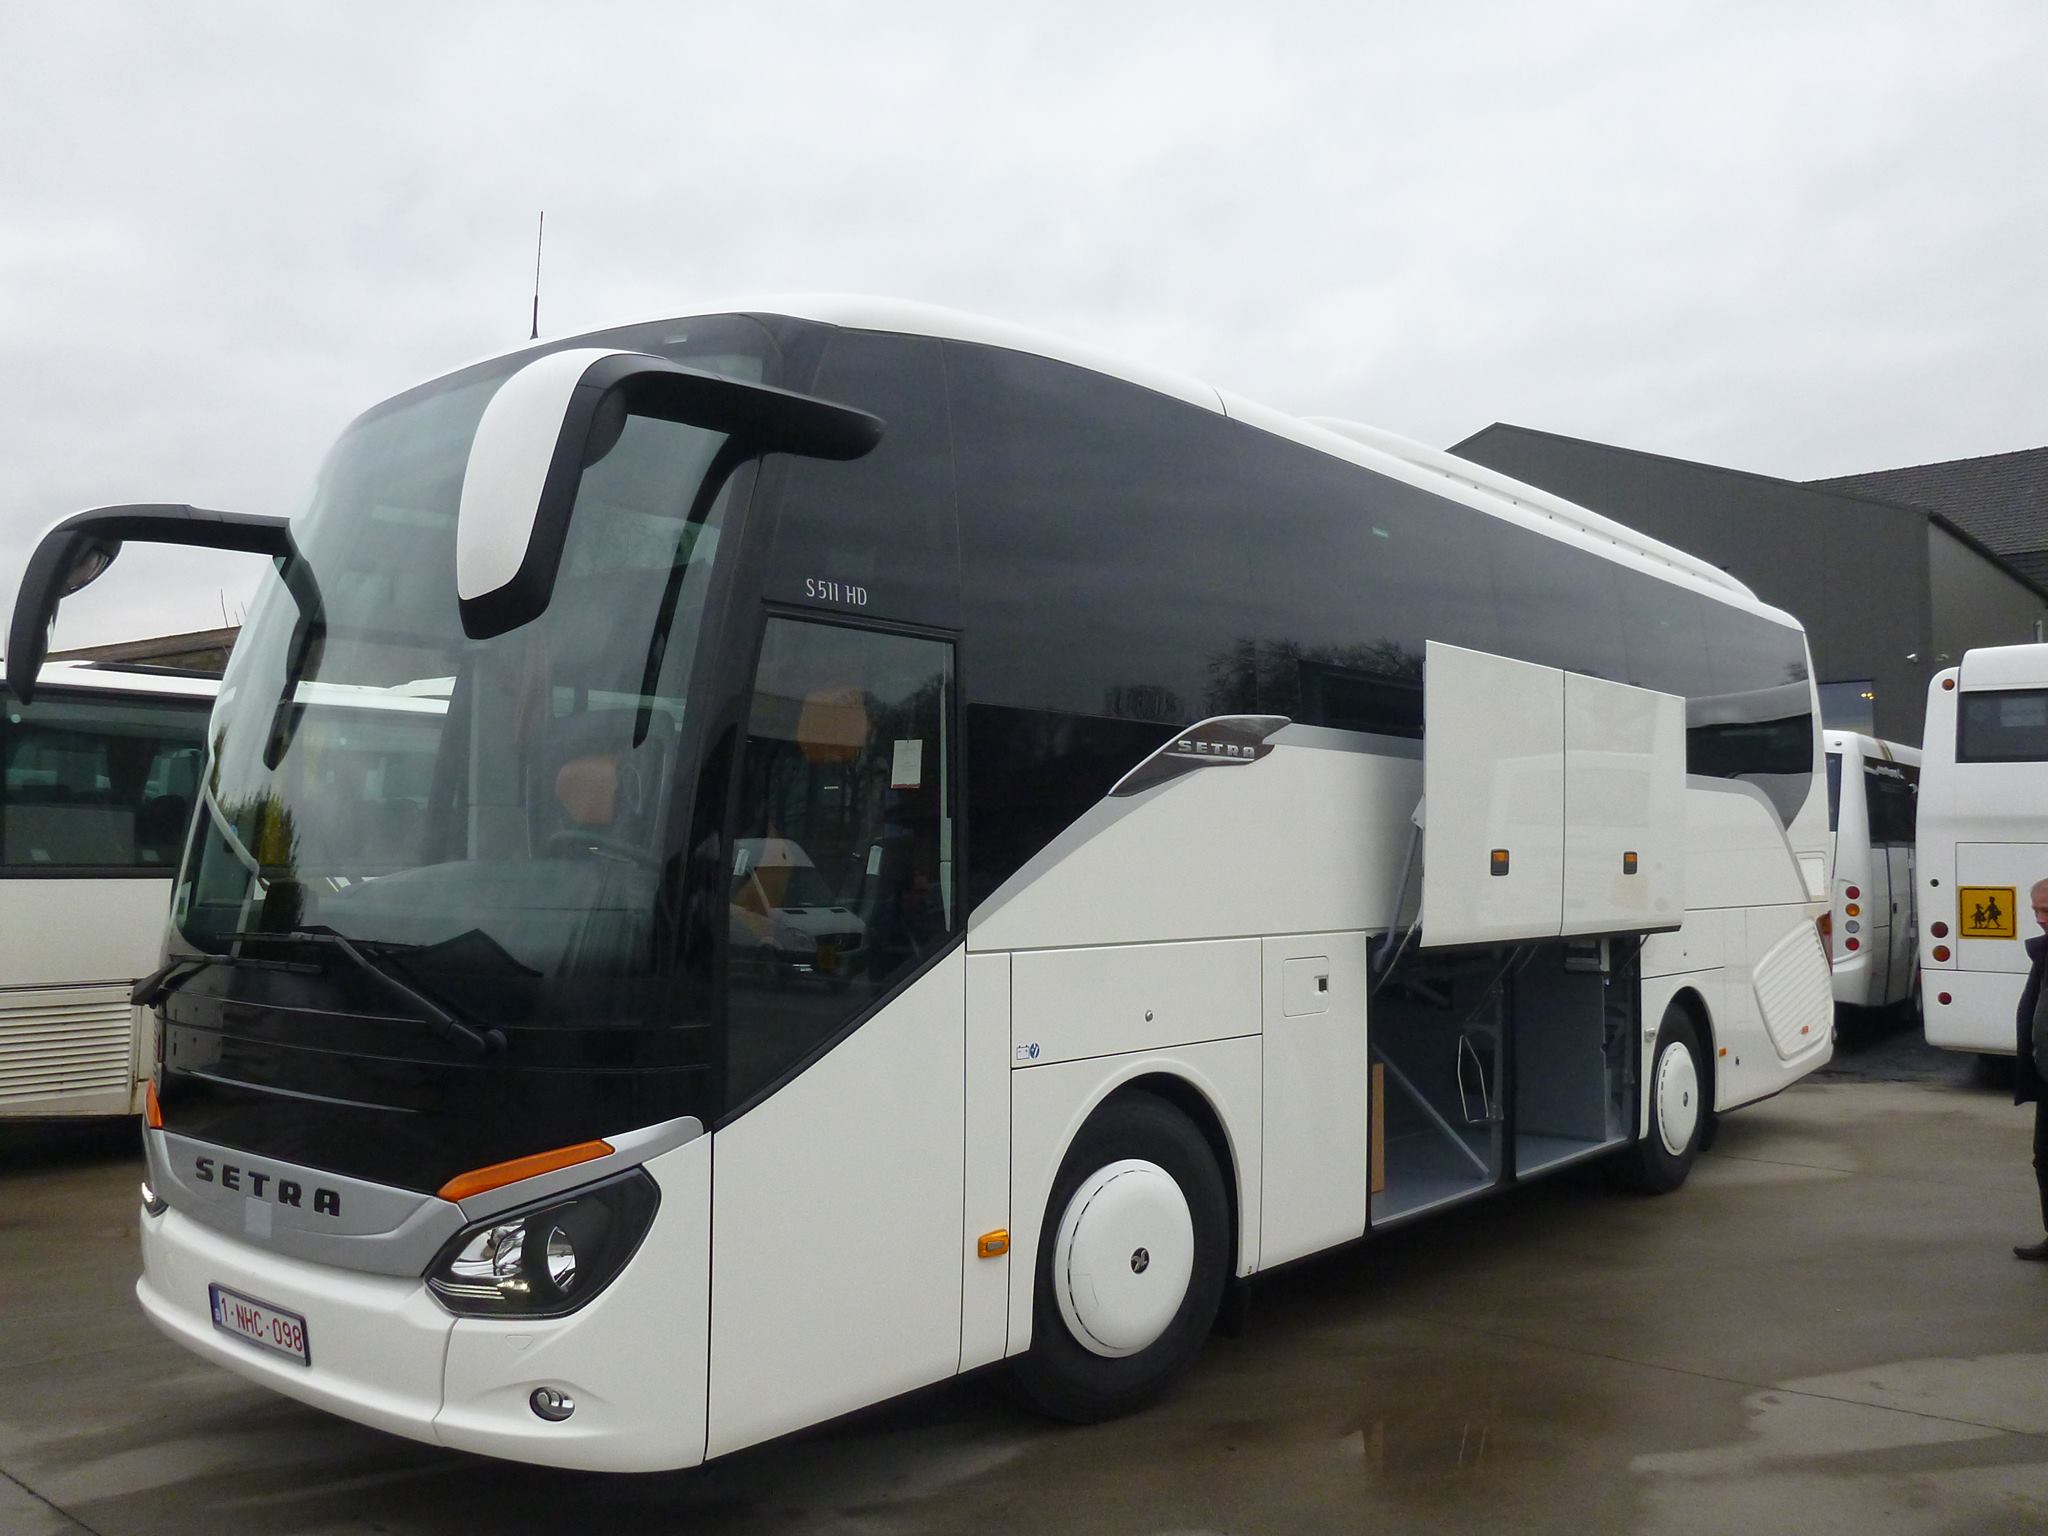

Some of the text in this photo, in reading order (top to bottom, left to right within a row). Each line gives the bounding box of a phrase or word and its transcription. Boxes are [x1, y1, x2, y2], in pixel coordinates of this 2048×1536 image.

[845, 585, 867, 606] HD
[1177, 740, 1255, 758] SETRA
[195, 1155, 341, 1217] SETRA
